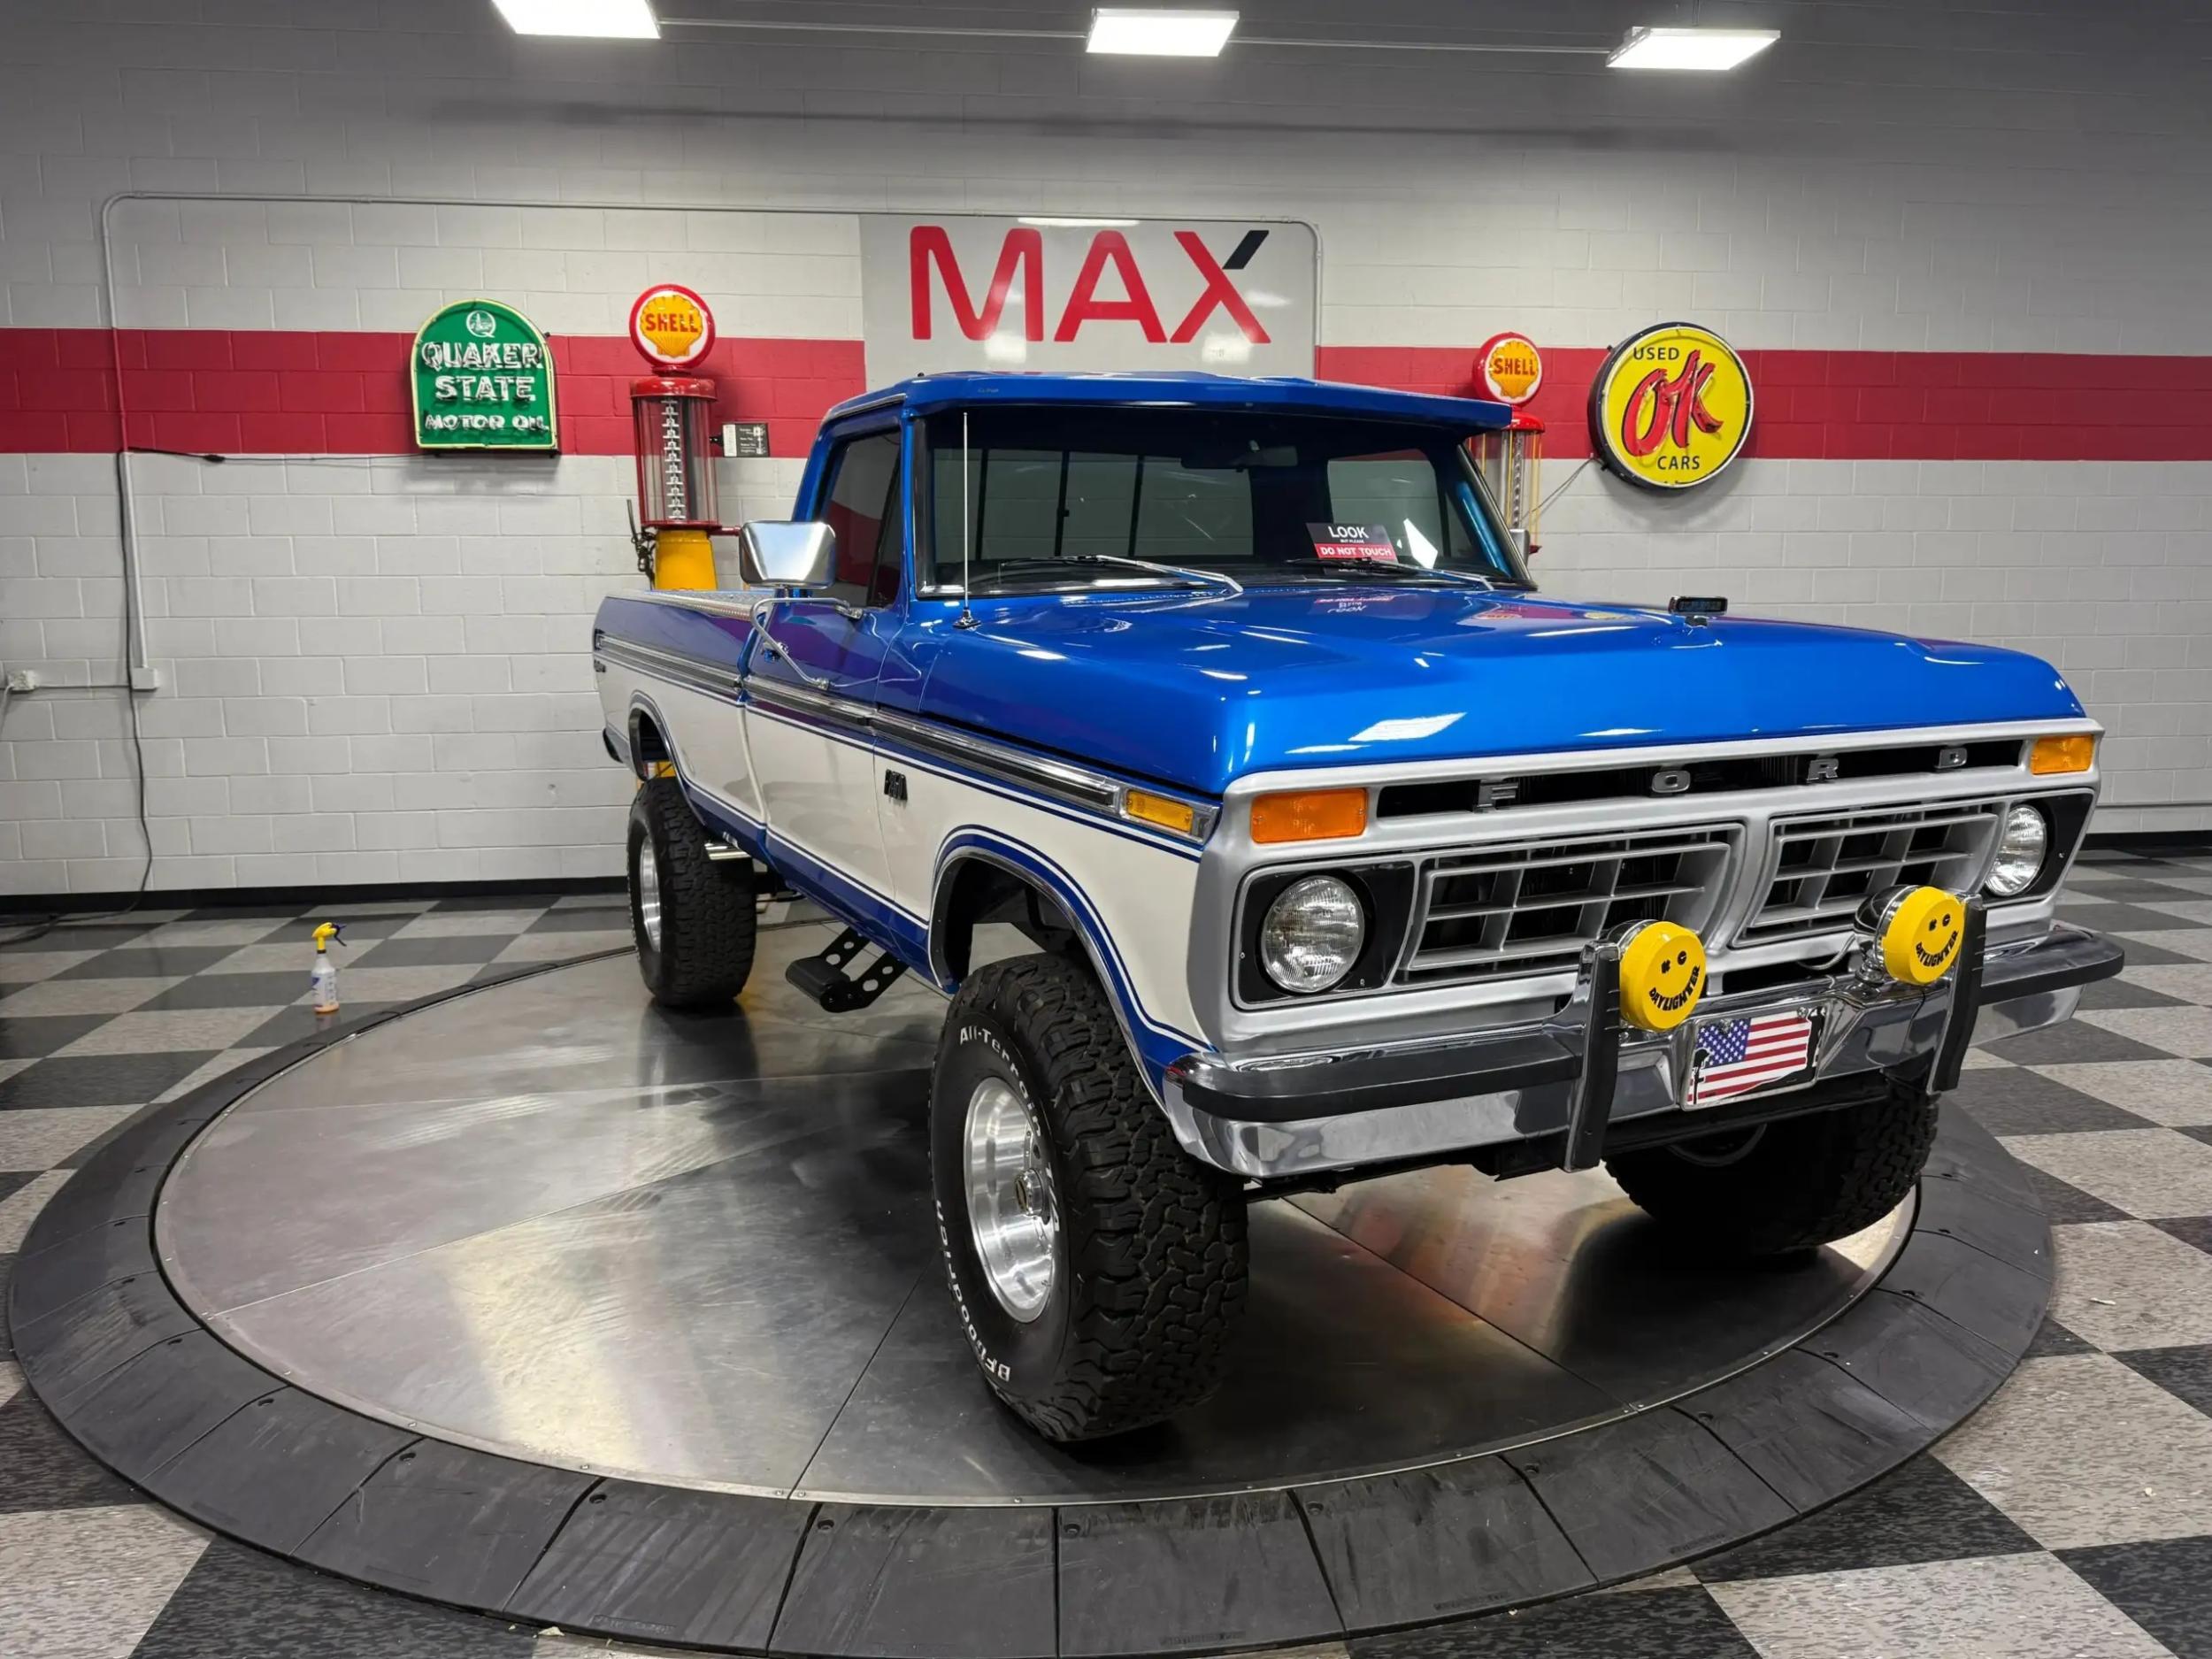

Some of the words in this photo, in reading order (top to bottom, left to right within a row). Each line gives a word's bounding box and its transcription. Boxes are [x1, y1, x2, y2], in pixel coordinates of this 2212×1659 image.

[910, 226, 1271, 343] MAX
[645, 313, 698, 333] SHELL
[421, 342, 544, 372] QUAKER
[1494, 357, 1536, 376] SHELL
[1632, 347, 1679, 361] USED
[435, 375, 536, 401] STATE
[1622, 349, 1724, 457] OK
[425, 414, 505, 430] MOTOR
[511, 414, 549, 431] OIL
[1657, 456, 1700, 470] CARS
[1328, 526, 1369, 538] LOOK
[1477, 748, 1968, 808] FORD
[1916, 930, 1959, 967] DAYLIGHTER
[1648, 965, 1701, 1011] DAYLIGHTER
